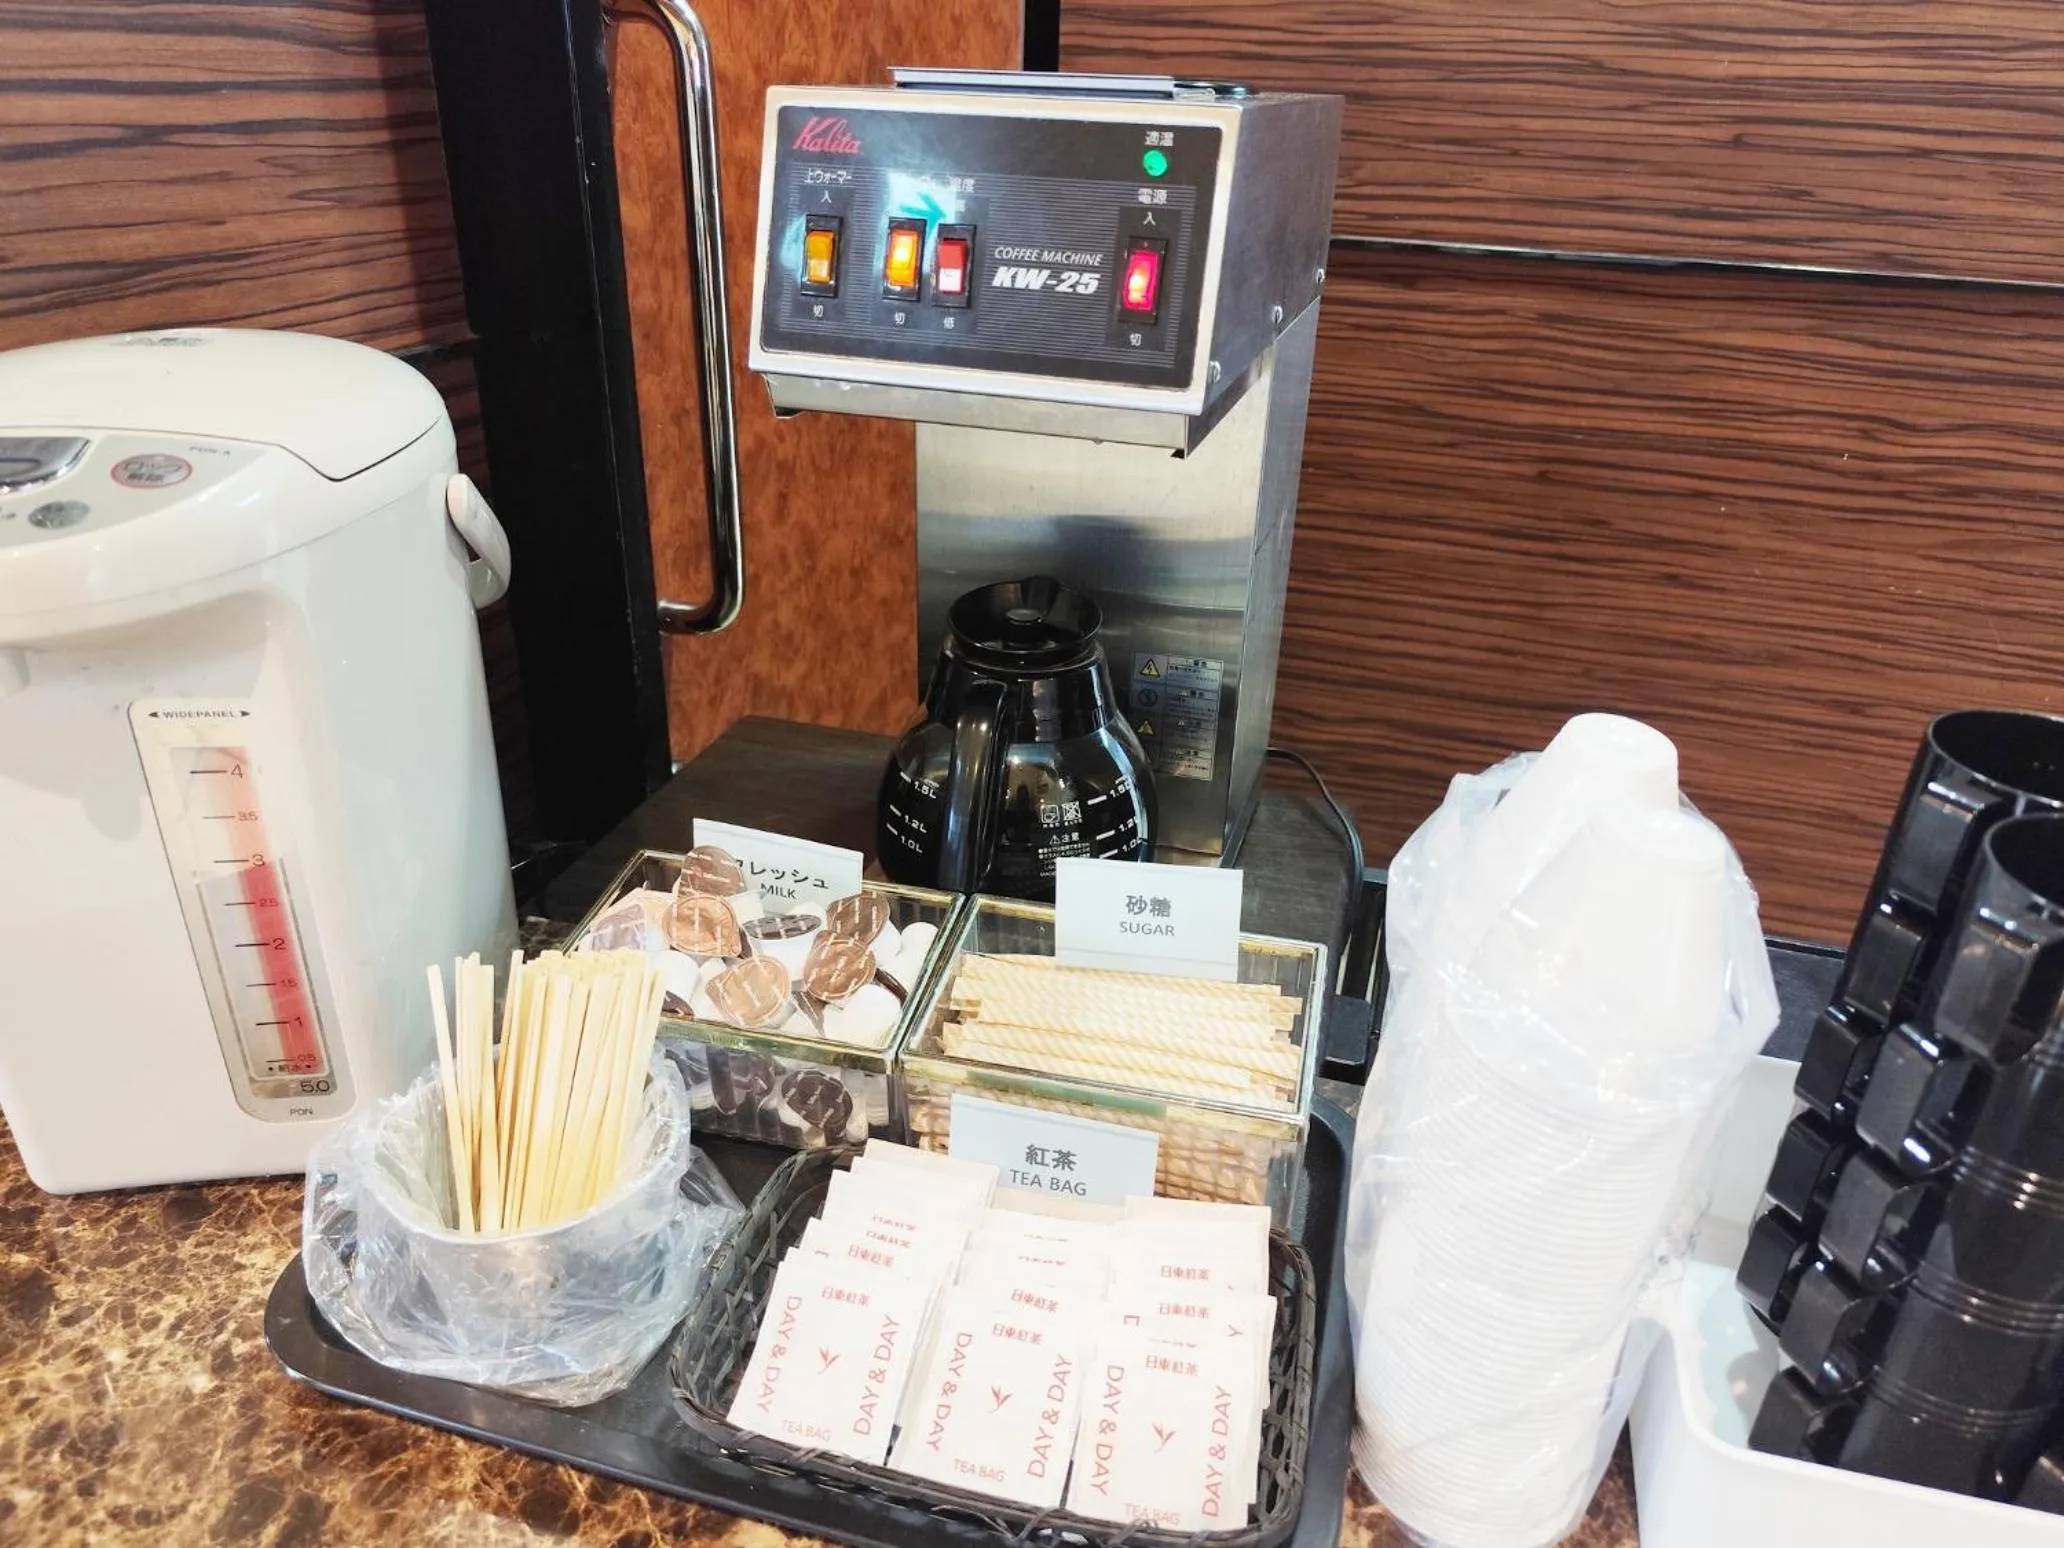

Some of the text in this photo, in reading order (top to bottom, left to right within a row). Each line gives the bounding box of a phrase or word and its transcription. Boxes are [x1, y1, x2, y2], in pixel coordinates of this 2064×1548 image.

[792, 115, 862, 155] Kalita
[804, 168, 852, 184] 上ウォーマー
[820, 190, 832, 204] 入
[1138, 188, 1168, 204] 電源
[1143, 212, 1156, 226] 入
[994, 246, 1103, 266] COFFEE MACHINE
[991, 266, 1101, 295] KW-25
[813, 304, 824, 318] 切
[1130, 333, 1142, 347] 切
[230, 763, 244, 780] 4
[914, 780, 937, 799] 1.5L
[904, 814, 928, 834] 1.2L
[900, 835, 923, 854] 1.0L
[252, 853, 266, 868] 3
[760, 882, 798, 900] MILK
[1125, 895, 1172, 918] 砂糖
[1119, 921, 1175, 937] SUGAR
[271, 937, 287, 951] 2
[293, 1015, 304, 1028] 1
[300, 1079, 331, 1094] 5.0
[1025, 1143, 1077, 1172] 紅茶
[1009, 1169, 1087, 1196] TEA BAG
[1160, 1265, 1210, 1281] 日東紅茶
[1159, 1302, 1210, 1319] 日東紅茶
[757, 1296, 803, 1413] DAY & DAY
[853, 1314, 901, 1436] DAY & DAY
[1145, 1354, 1199, 1377] 日東紅茶
[926, 1332, 973, 1452] DAY & DAY
[1027, 1354, 1073, 1479] DAY & DAY
[781, 1419, 832, 1442] TEA BAG
[1091, 1364, 1125, 1496] DAY & DAY
[1201, 1385, 1233, 1518] DAY & DAY
[953, 1458, 1007, 1482] TEA BAG
[1124, 1502, 1181, 1526] TEA BAG
